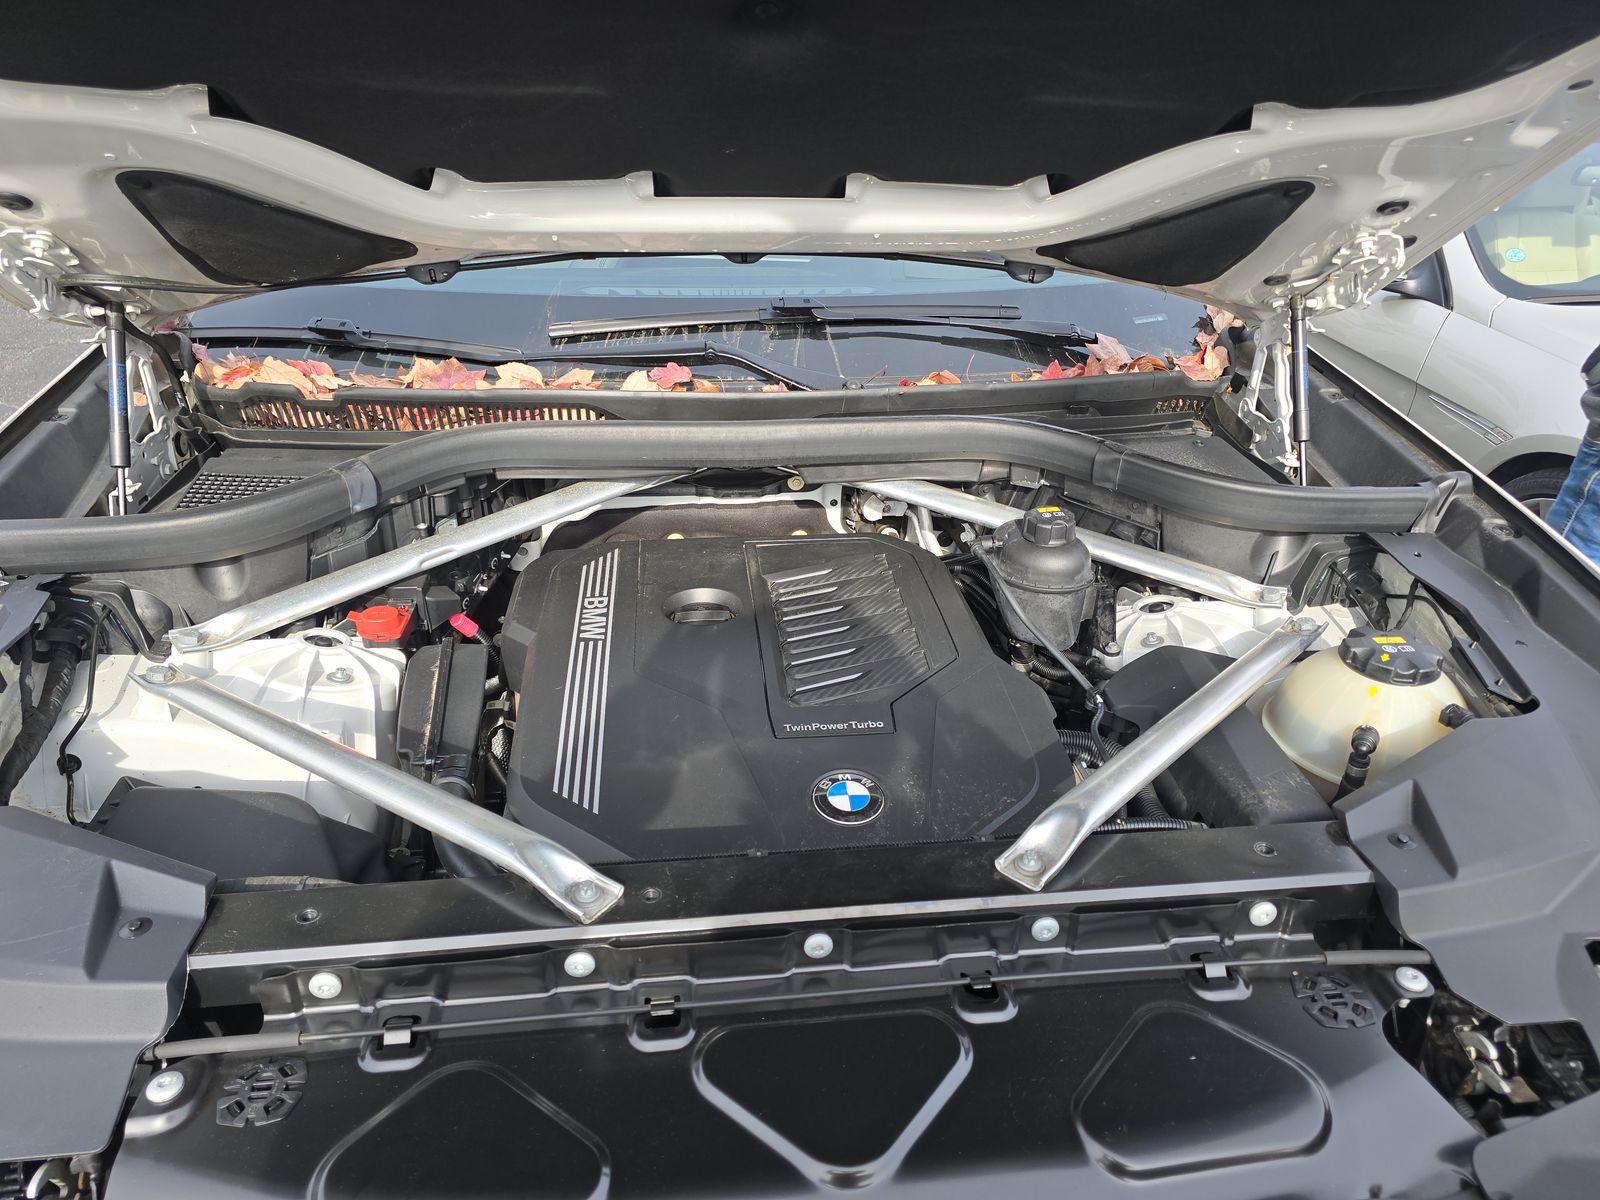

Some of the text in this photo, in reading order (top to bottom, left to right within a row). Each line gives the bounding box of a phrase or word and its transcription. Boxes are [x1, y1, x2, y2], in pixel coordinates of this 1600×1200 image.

[579, 596, 608, 639] BMW
[849, 720, 885, 729] Turbo
[819, 773, 875, 789] BMW
